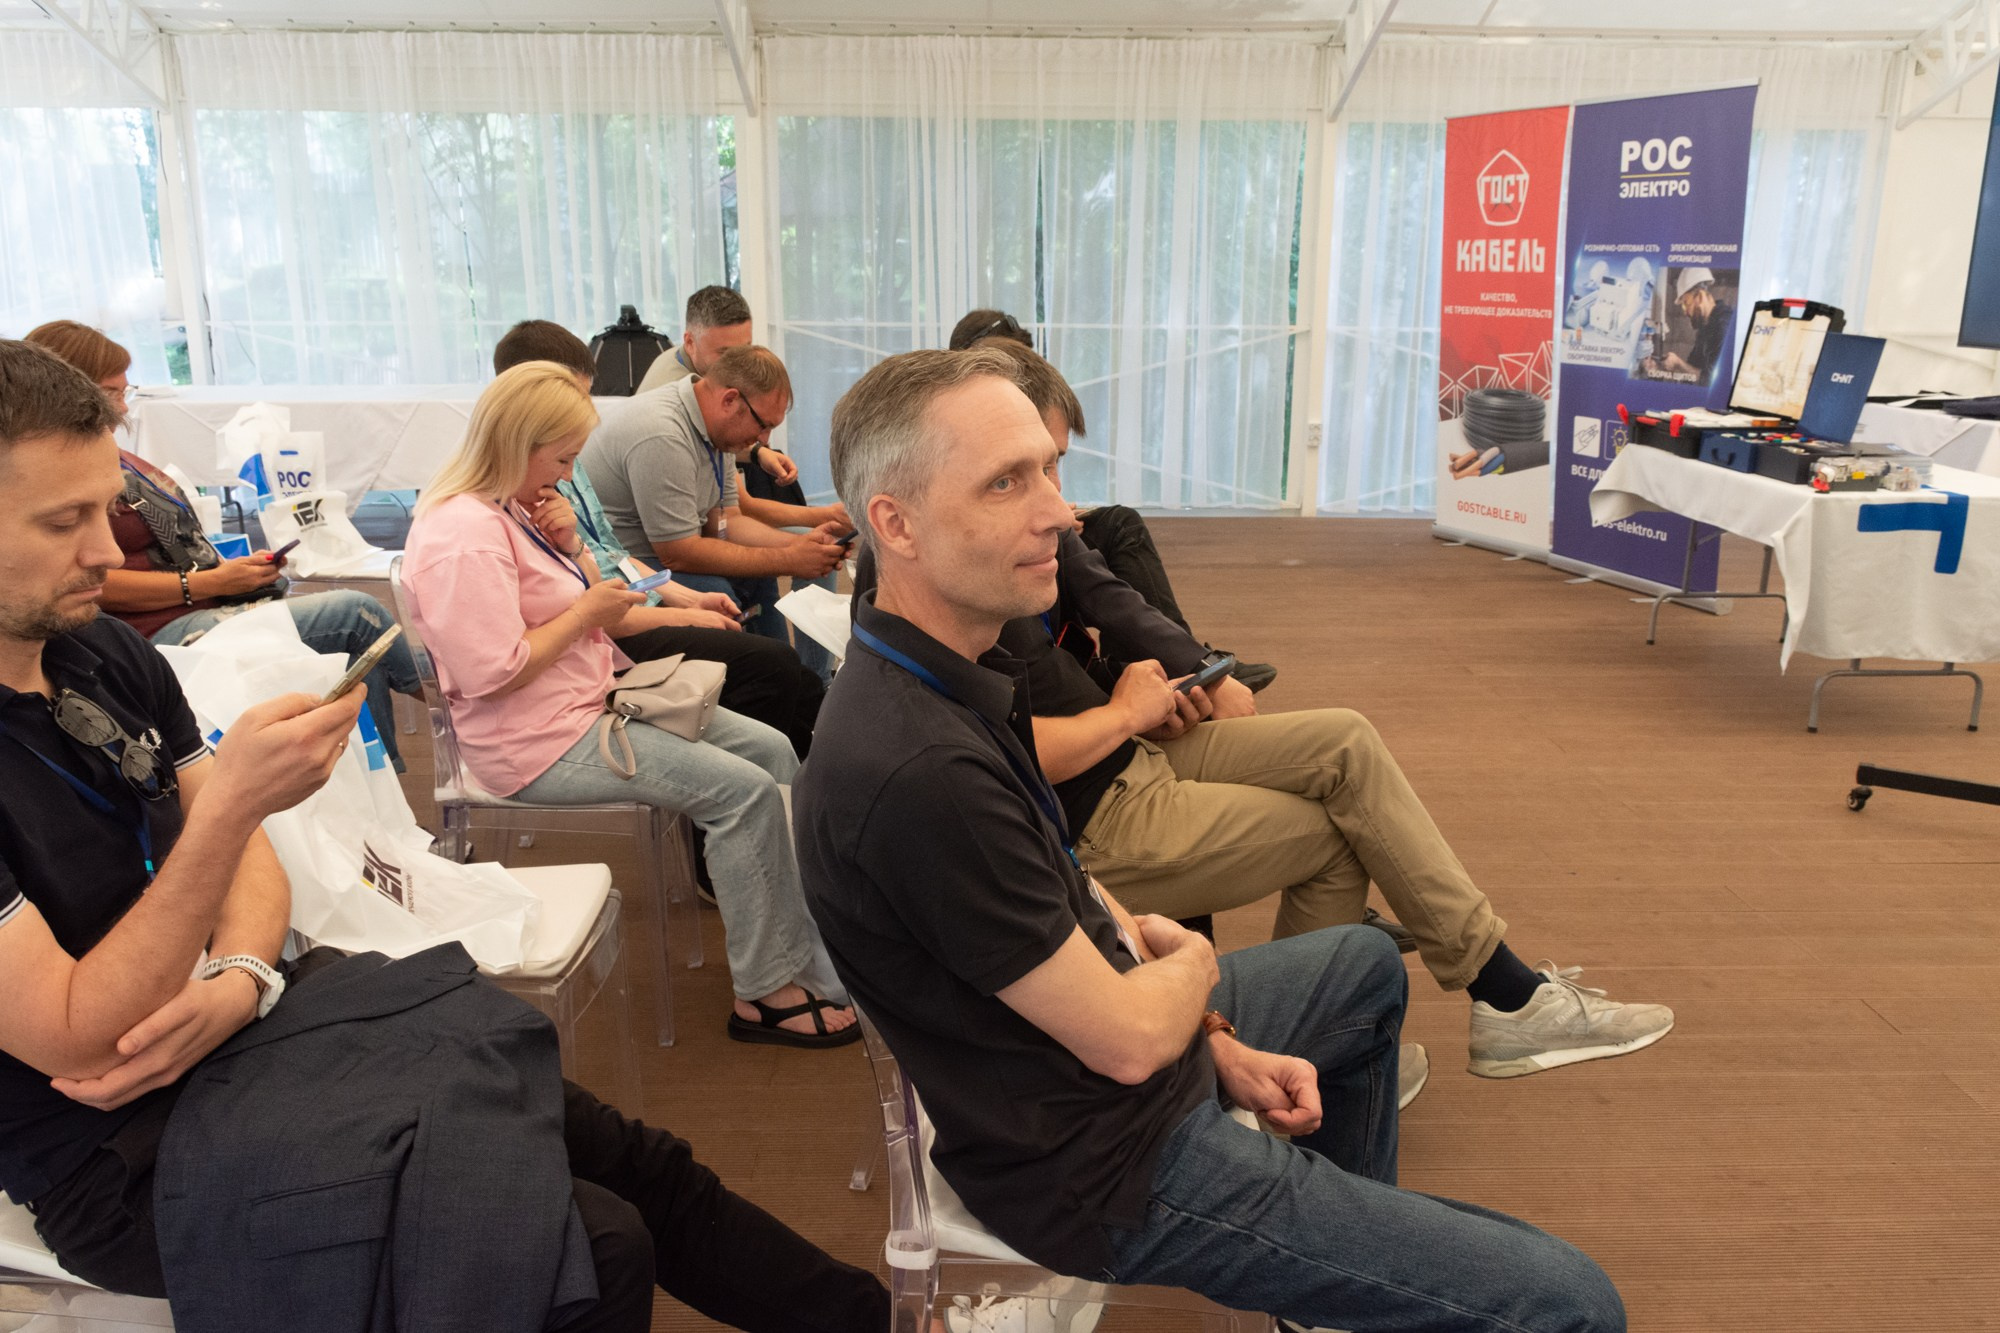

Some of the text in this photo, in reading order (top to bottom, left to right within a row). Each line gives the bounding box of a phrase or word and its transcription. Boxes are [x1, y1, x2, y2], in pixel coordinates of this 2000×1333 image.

[1620, 135, 1693, 173] РОС
[1480, 173, 1529, 205] ГОСТ
[1619, 179, 1690, 199] ЭЛЕКТРО
[1456, 238, 1546, 273] КАБЕЛЬ
[1645, 244, 1660, 253] СЕТЬ
[1670, 243, 1738, 253] ЭЛЕКТРОМОНТАЖНАЯ
[1667, 254, 1712, 264] ОРГАНИЗАЦИЯ
[1480, 292, 1518, 304] КАЧЕСТВО,
[1444, 305, 1553, 319] НЕ ТРЕБУЮЩЕЕ ДОКАЗАТЕЛЬСТВ
[277, 471, 312, 488] РОС
[1571, 464, 1606, 482] ВСЕ ДЛ
[1457, 500, 1527, 524] GOSTCABLE.RU
